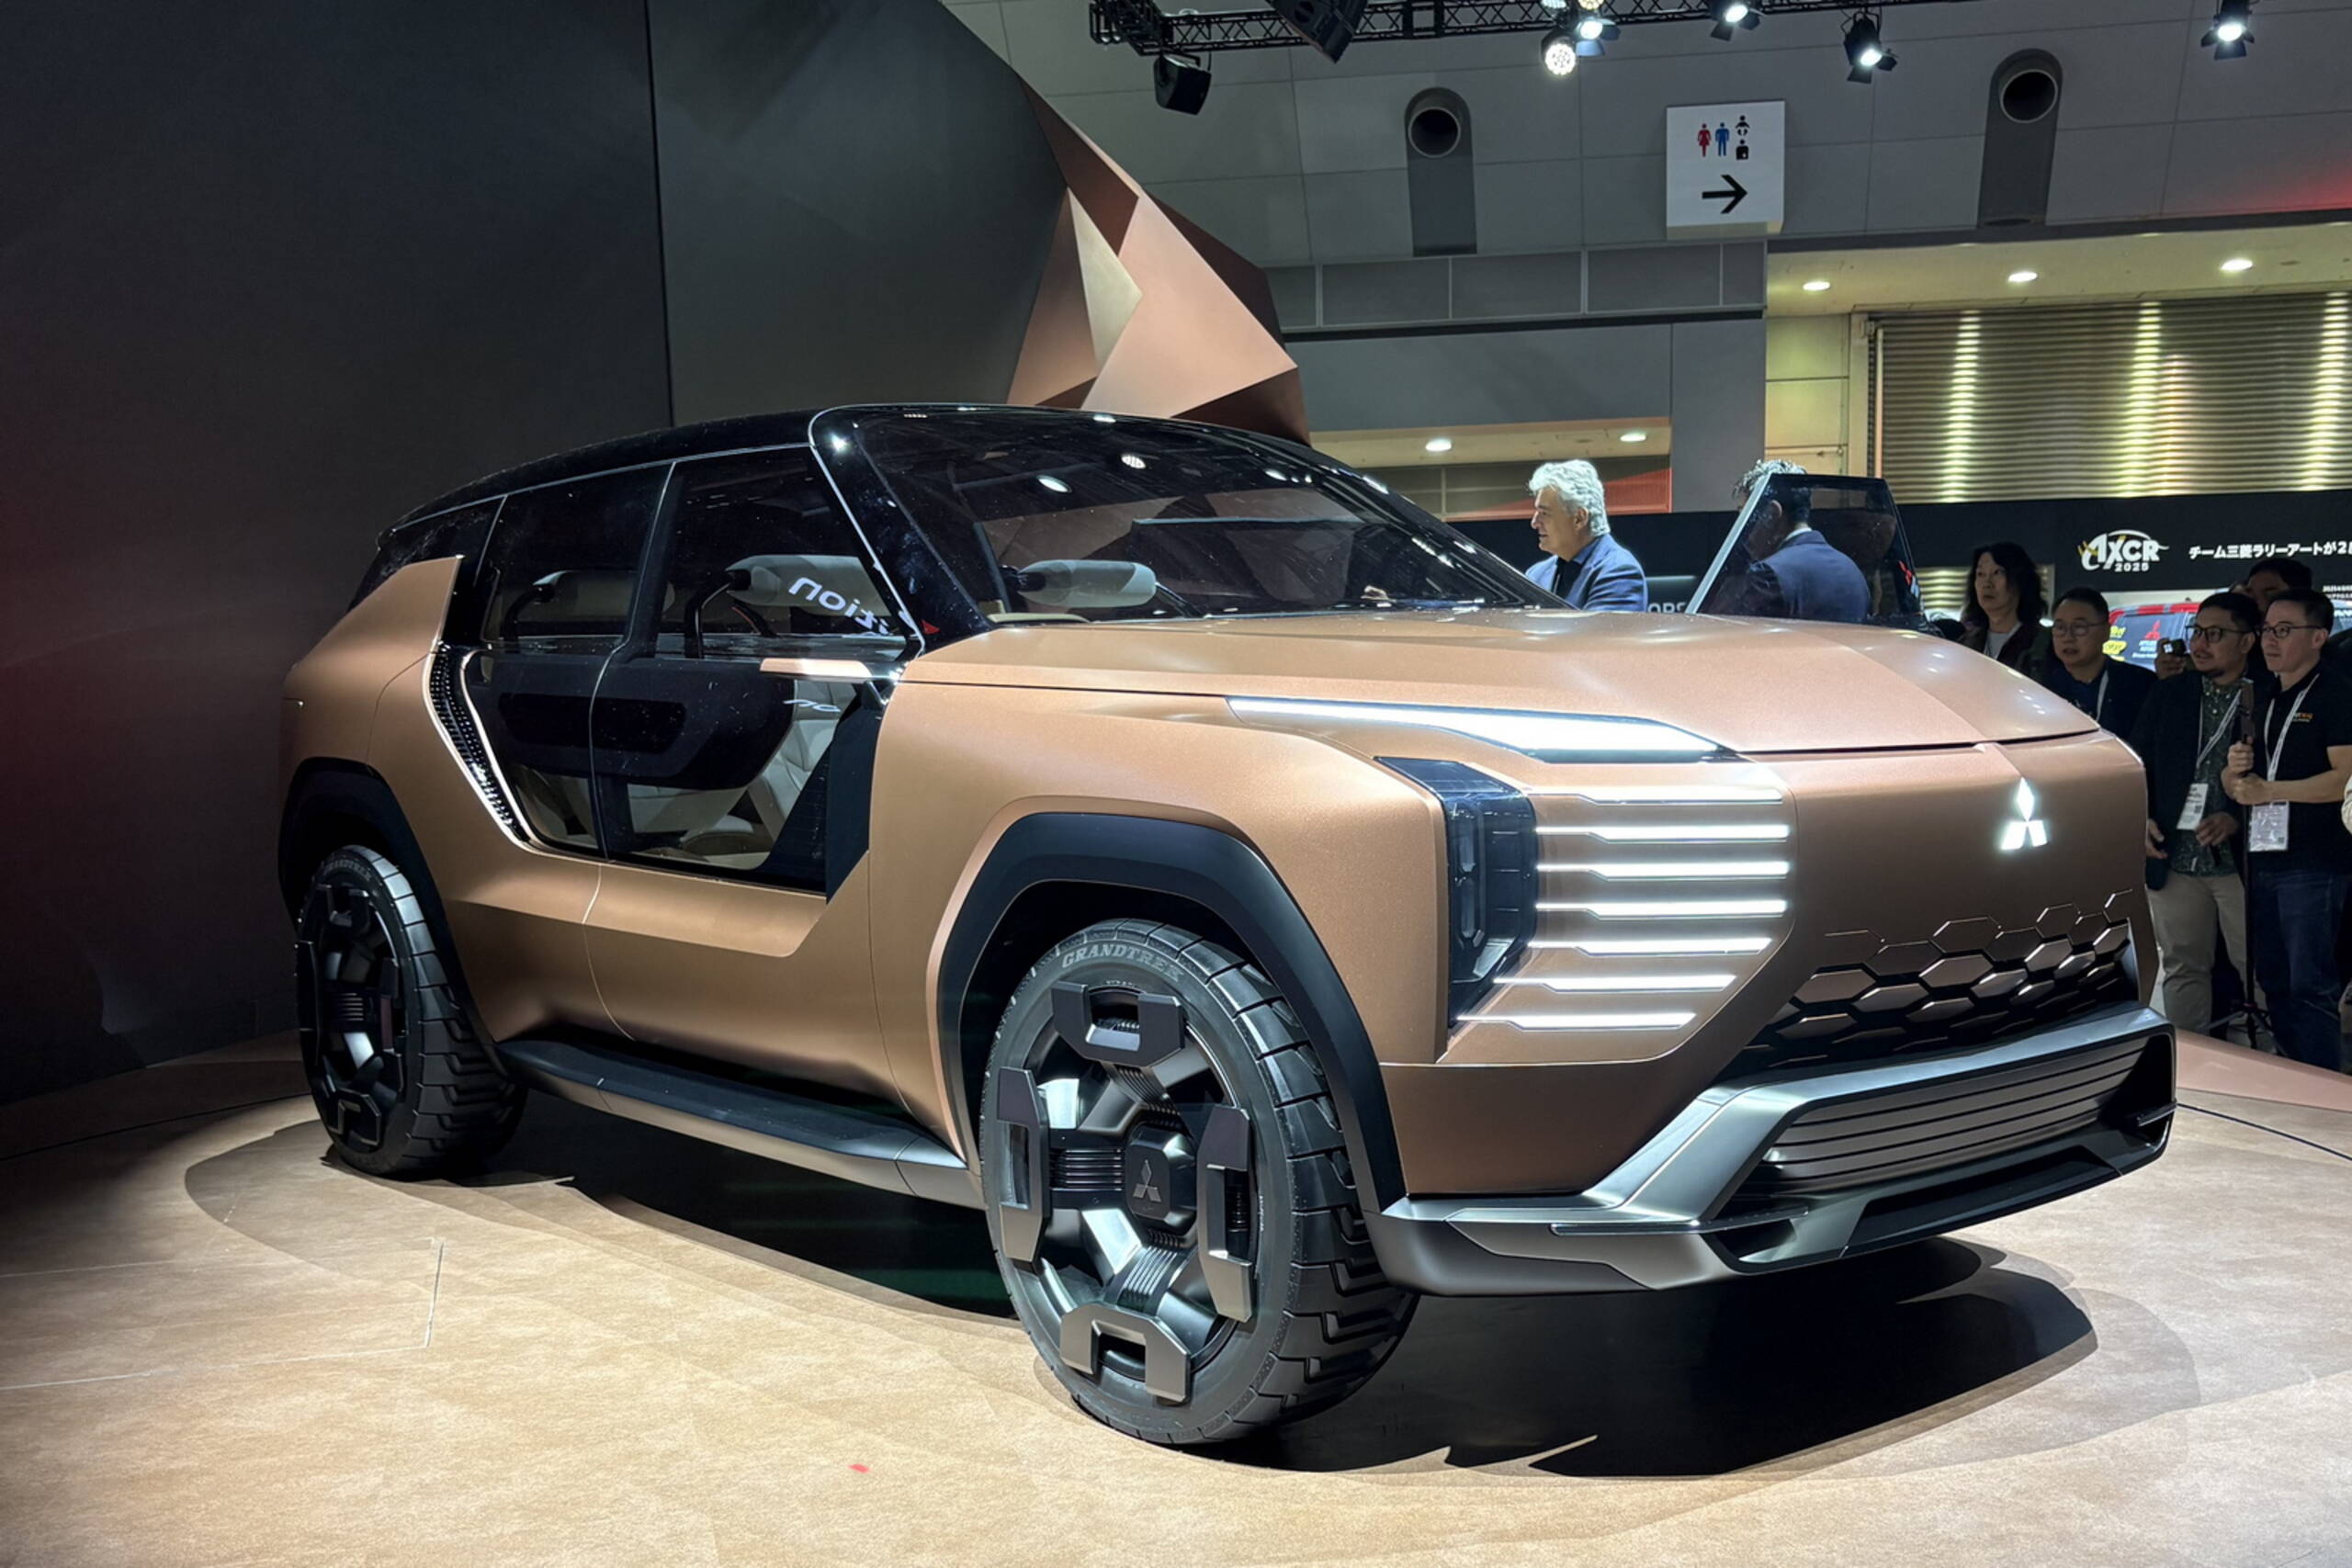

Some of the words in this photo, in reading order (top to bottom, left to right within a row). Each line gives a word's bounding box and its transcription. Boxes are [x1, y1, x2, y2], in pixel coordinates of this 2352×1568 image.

[2079, 531, 2162, 570] AXCR
[2188, 541, 2352, 559] チーム三菱ラリーアートが2
[2114, 562, 2150, 572] 2025
[1062, 943, 1184, 982] GRANDTREK
